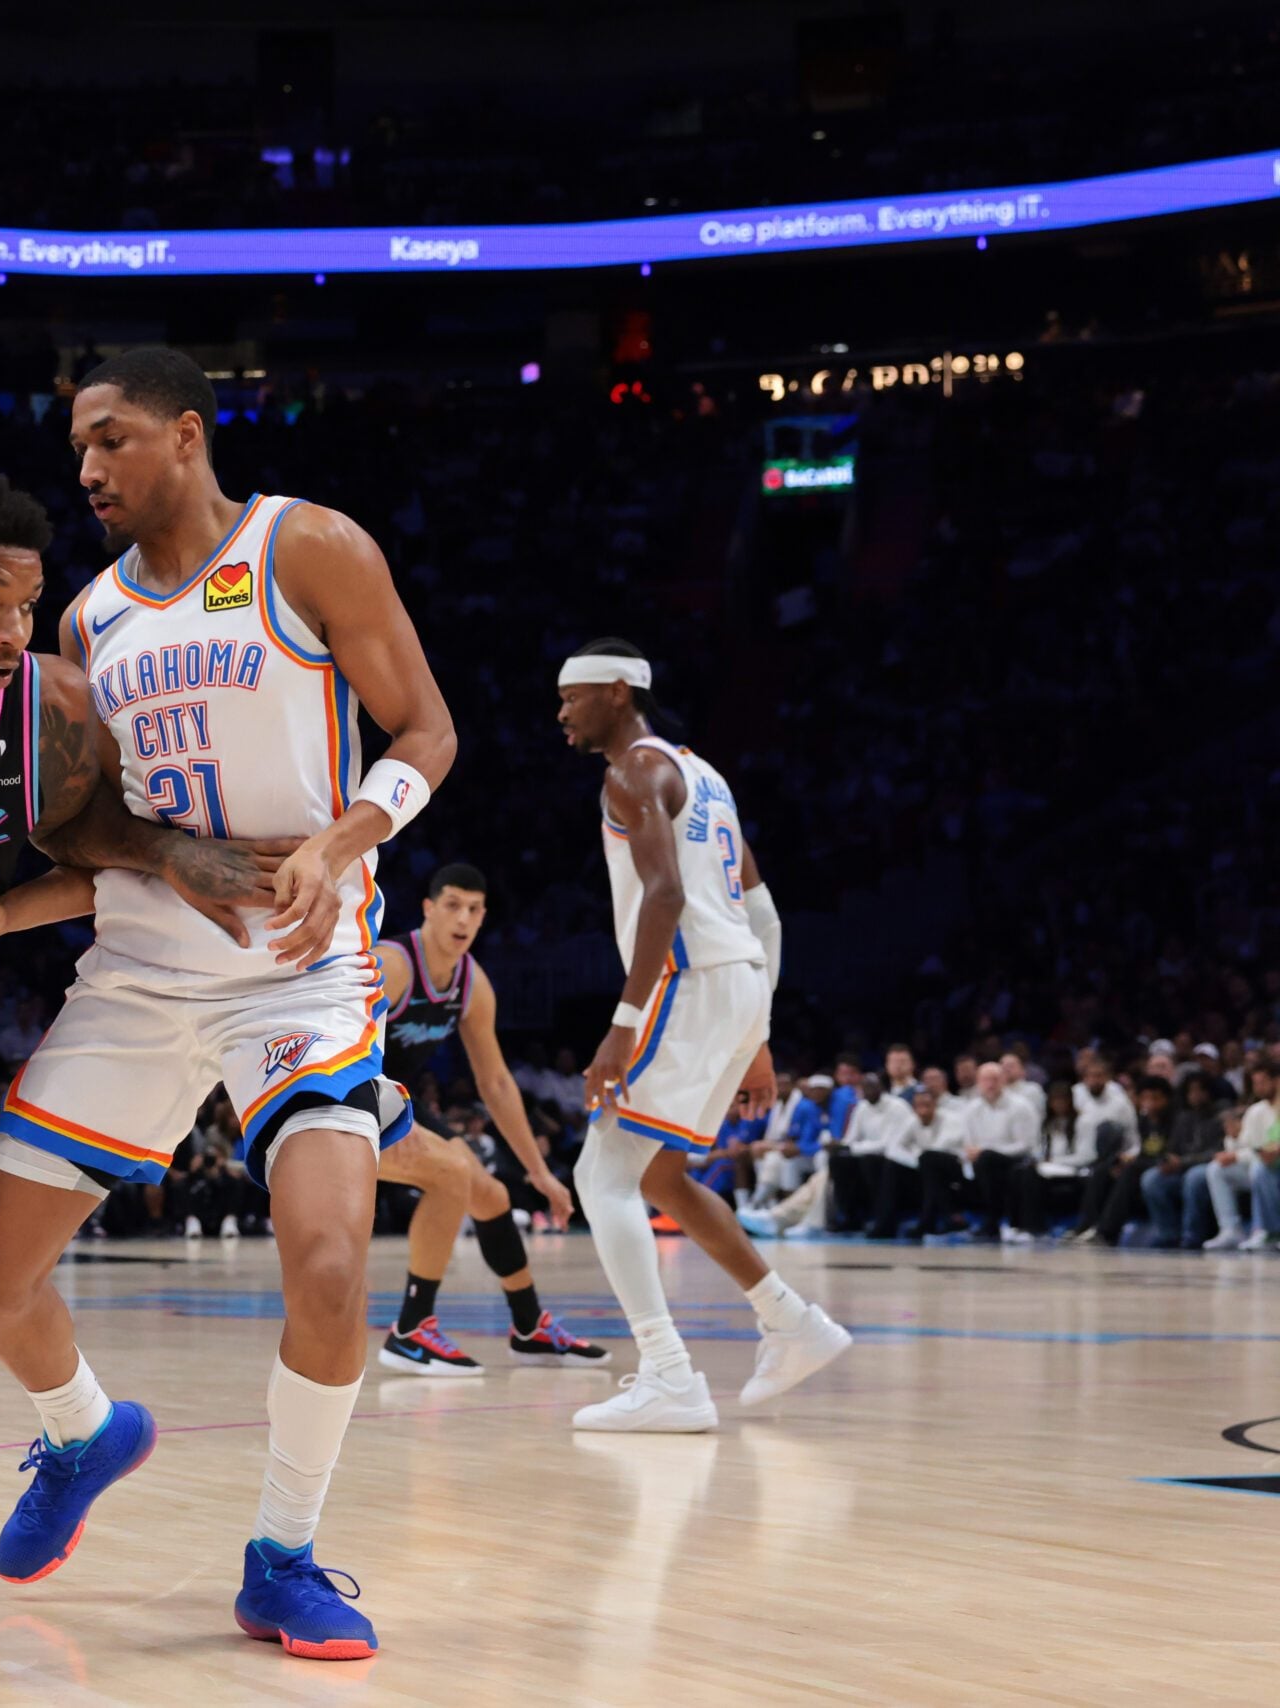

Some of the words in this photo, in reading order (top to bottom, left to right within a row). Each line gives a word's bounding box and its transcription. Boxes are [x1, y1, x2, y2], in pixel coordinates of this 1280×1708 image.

[699, 220, 753, 246] One
[755, 212, 874, 246] platform.
[878, 199, 1016, 232] Everything
[1017, 193, 1050, 218] IT.
[19, 238, 144, 269] Everything
[146, 240, 176, 264] IT.
[390, 236, 479, 266] Kaseya
[89, 639, 266, 726] OKLAHOMA
[131, 701, 211, 761] CITY
[144, 759, 233, 840] 21
[715, 821, 745, 906] 2
